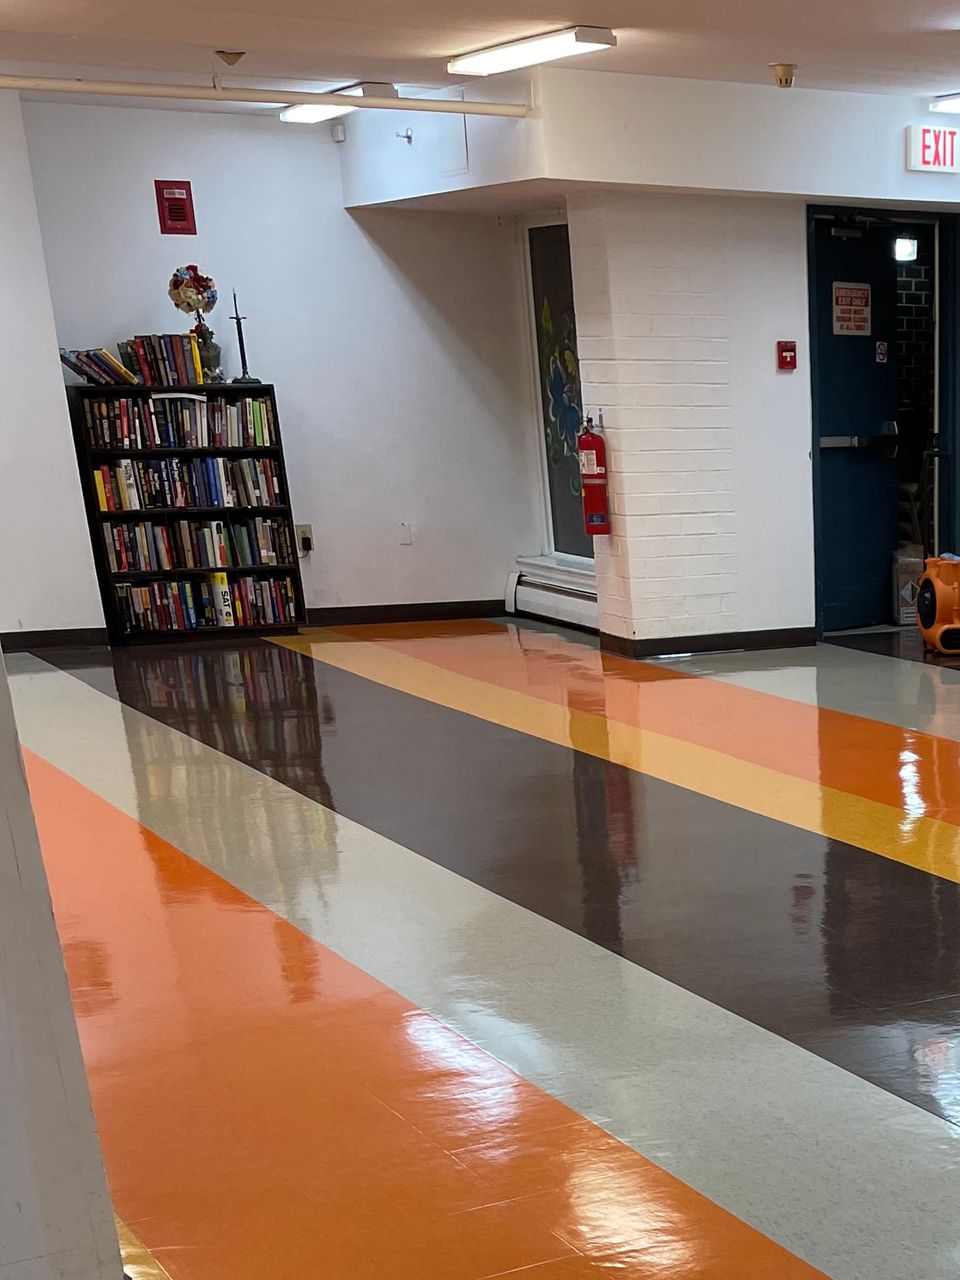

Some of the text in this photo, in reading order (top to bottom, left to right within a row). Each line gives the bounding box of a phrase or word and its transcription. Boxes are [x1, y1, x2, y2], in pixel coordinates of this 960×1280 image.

[921, 128, 957, 167] EXIT
[838, 296, 851, 304] EXIT
[221, 590, 231, 608] SAT
